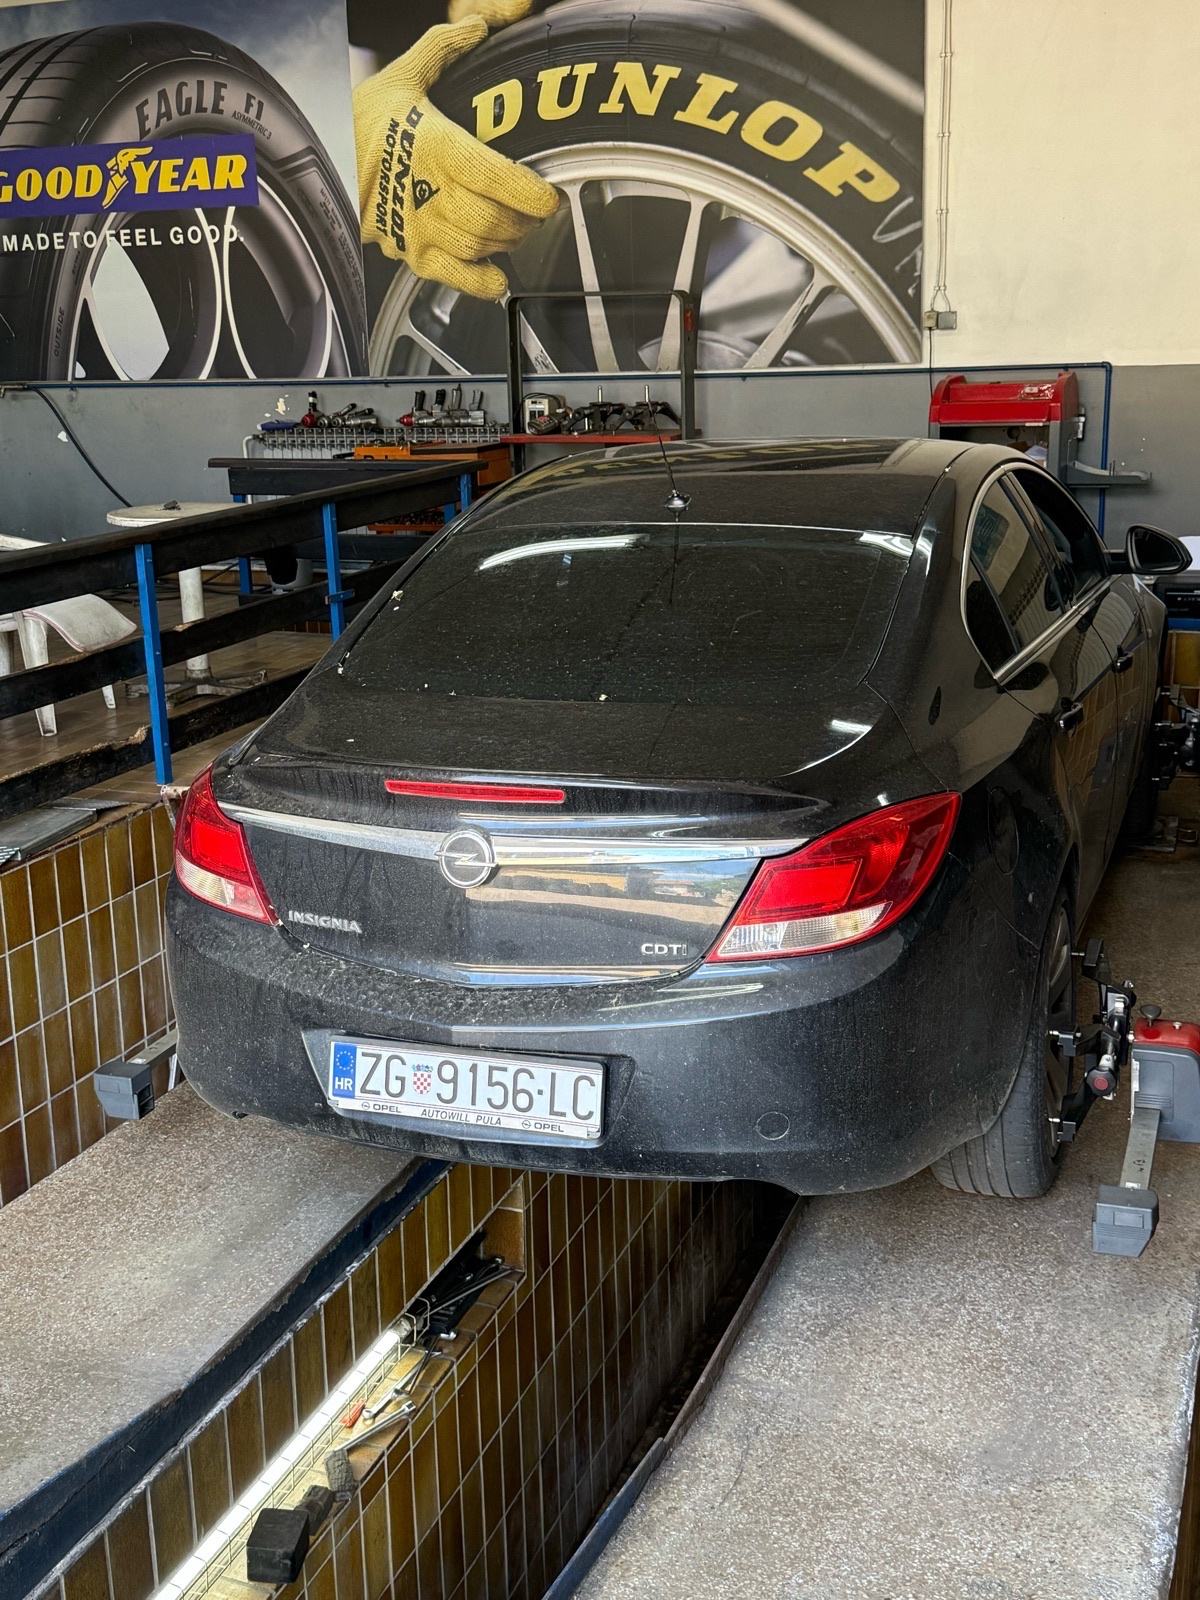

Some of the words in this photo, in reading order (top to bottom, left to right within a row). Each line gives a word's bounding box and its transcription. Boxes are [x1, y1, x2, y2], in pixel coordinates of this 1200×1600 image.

[135, 80, 228, 140] EAGLE
[244, 92, 264, 121] F1
[231, 110, 268, 137] ASYMMETRIC
[472, 62, 900, 202] DUNLOP
[376, 118, 400, 237] MOTORSPORT
[391, 105, 423, 252] DUNLOP
[2, 232, 65, 251] MADE
[68, 230, 97, 249] TO
[106, 227, 162, 247] FEEL
[54, 306, 65, 357] OUTSIDE
[288, 910, 362, 933] INSIGNIA
[334, 1076, 354, 1091] HR
[360, 1051, 407, 1098] ZG
[372, 1102, 402, 1114] OPEL
[420, 1108, 470, 1123] AUTOWILL
[475, 1114, 502, 1126] PULA
[533, 1122, 565, 1133] OPEL
